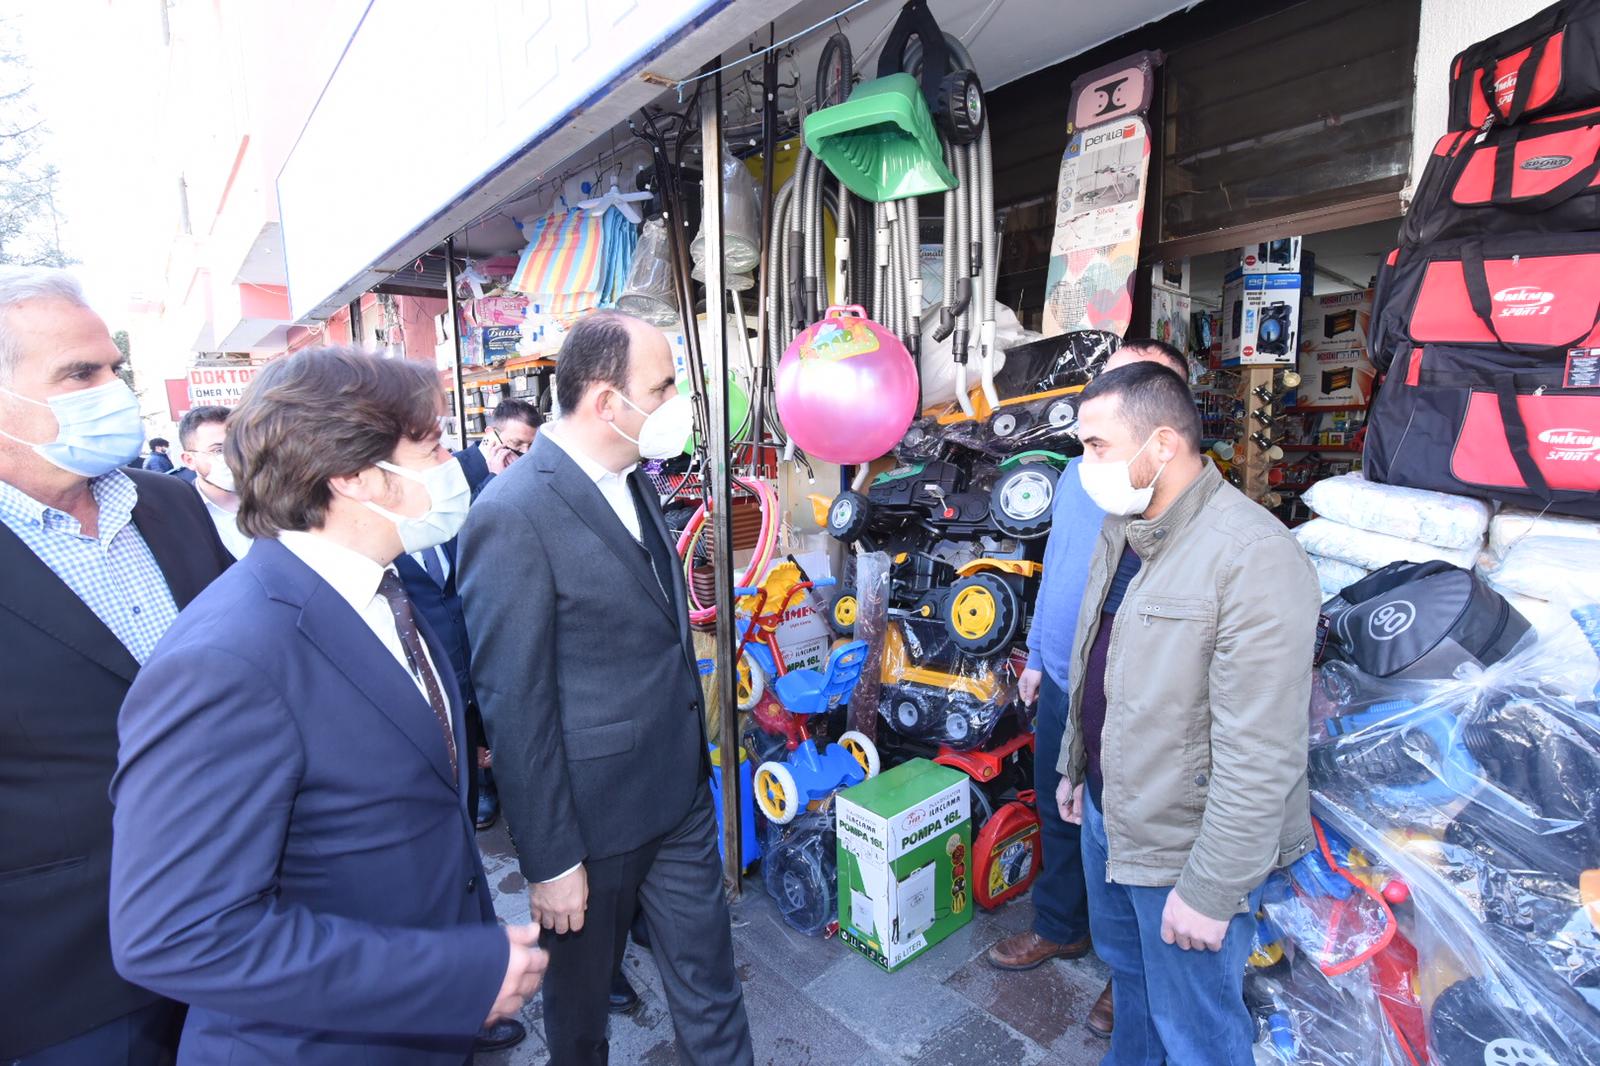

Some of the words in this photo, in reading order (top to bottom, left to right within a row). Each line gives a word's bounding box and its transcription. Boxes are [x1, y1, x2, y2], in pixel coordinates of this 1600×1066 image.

[1498, 306, 1540, 317] SPORT
[225, 386, 246, 396] YIL
[1545, 450, 1593, 462] SPORT
[1373, 606, 1408, 633] 90
[839, 820, 869, 842] POMPA
[869, 835, 885, 851] 16L
[901, 820, 943, 850] POMPA
[943, 809, 962, 826] 16L
